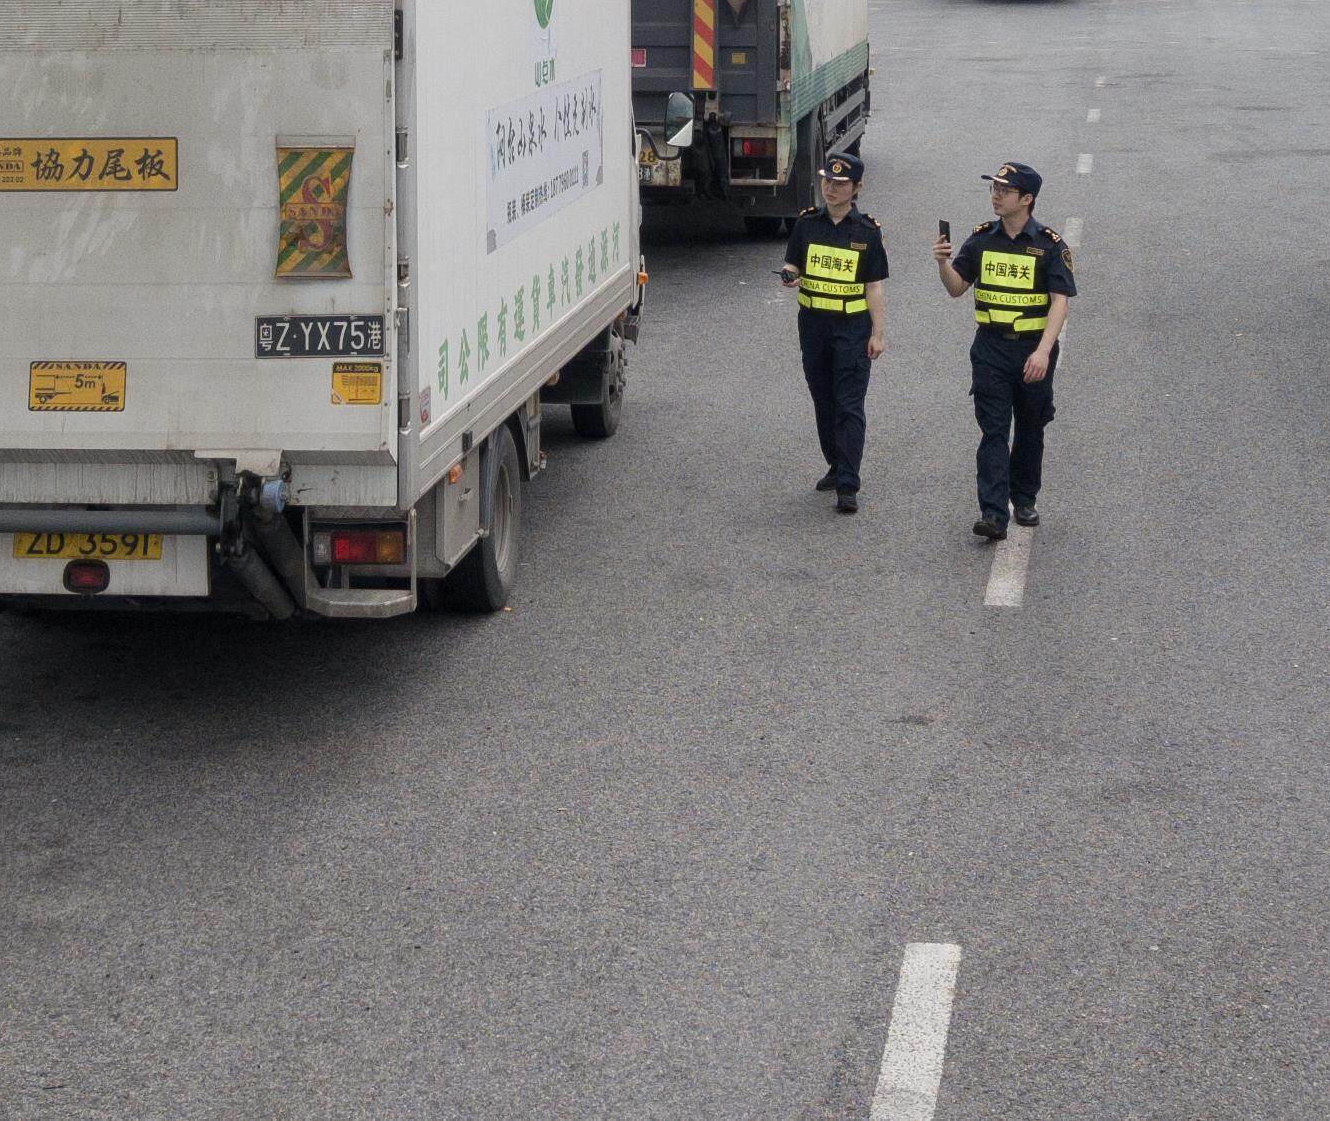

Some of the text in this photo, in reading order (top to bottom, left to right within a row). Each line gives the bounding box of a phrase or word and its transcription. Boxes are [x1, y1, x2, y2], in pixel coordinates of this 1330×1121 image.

[30, 147, 171, 182] 協力尾板
[810, 253, 854, 273] 中国海关
[985, 260, 1030, 280] 中国海关
[822, 283, 860, 293] CUSTOMS
[976, 290, 1043, 305] CHINA CUSTOMS
[74, 373, 96, 389] 5m
